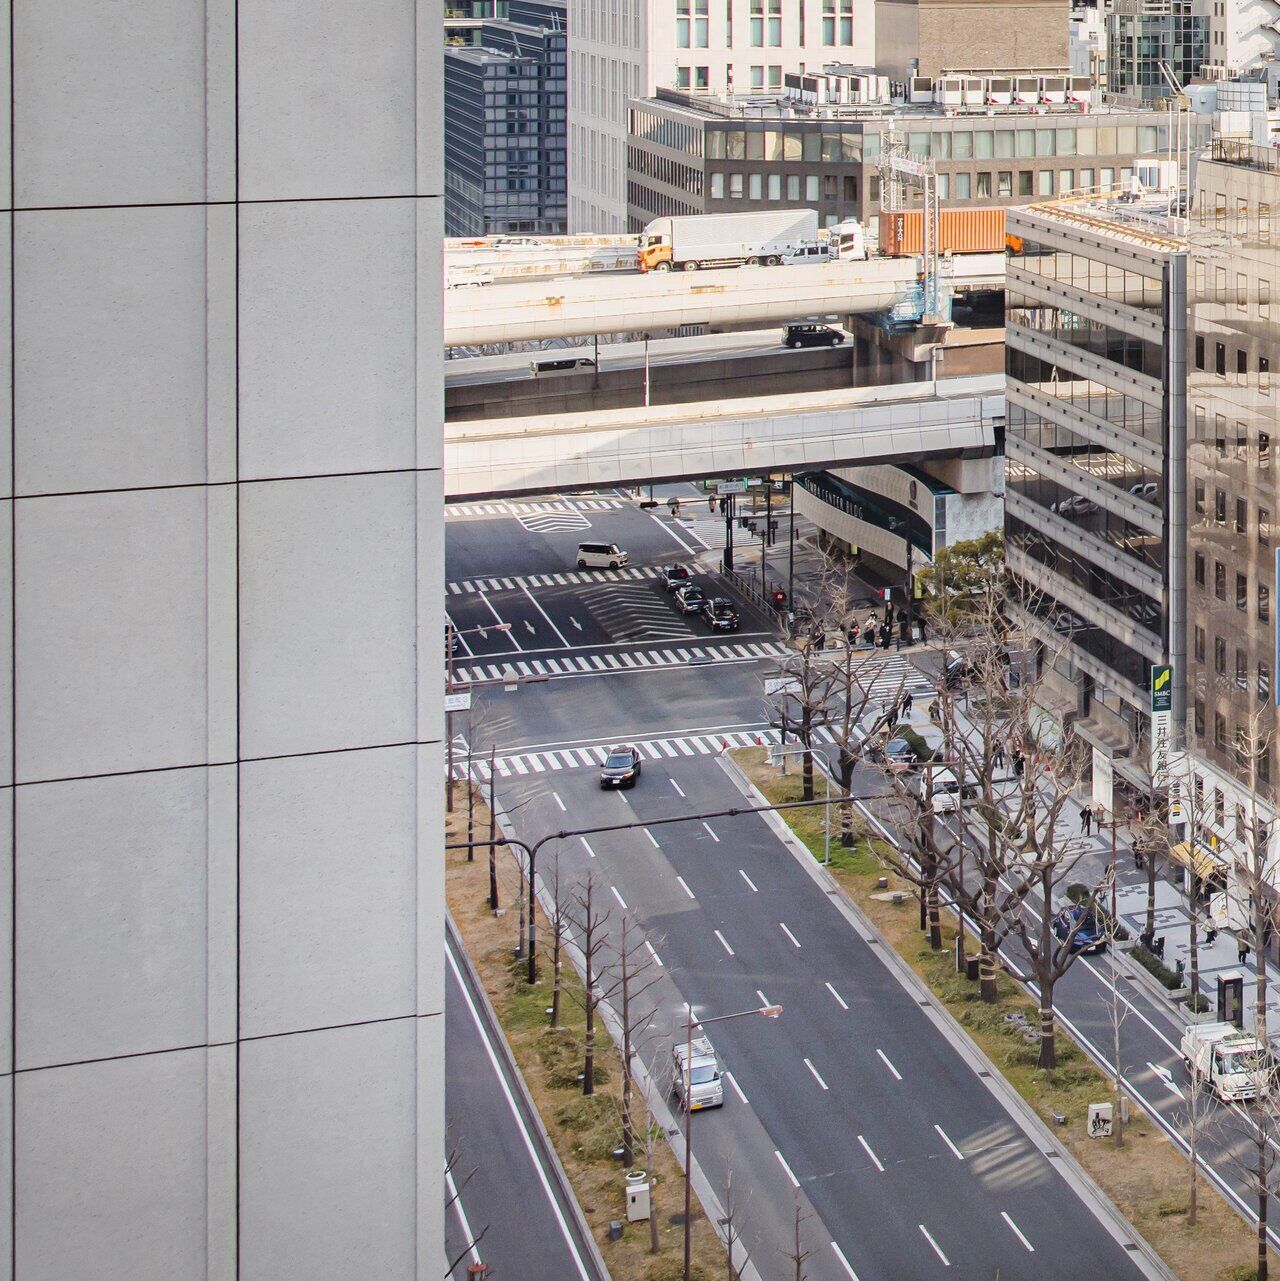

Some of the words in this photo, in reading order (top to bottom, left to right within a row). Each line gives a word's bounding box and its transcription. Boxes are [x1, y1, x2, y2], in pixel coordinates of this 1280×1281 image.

[821, 489, 844, 510] CENTER
[845, 500, 864, 520] BLDG
[1154, 689, 1171, 698] SMBC
